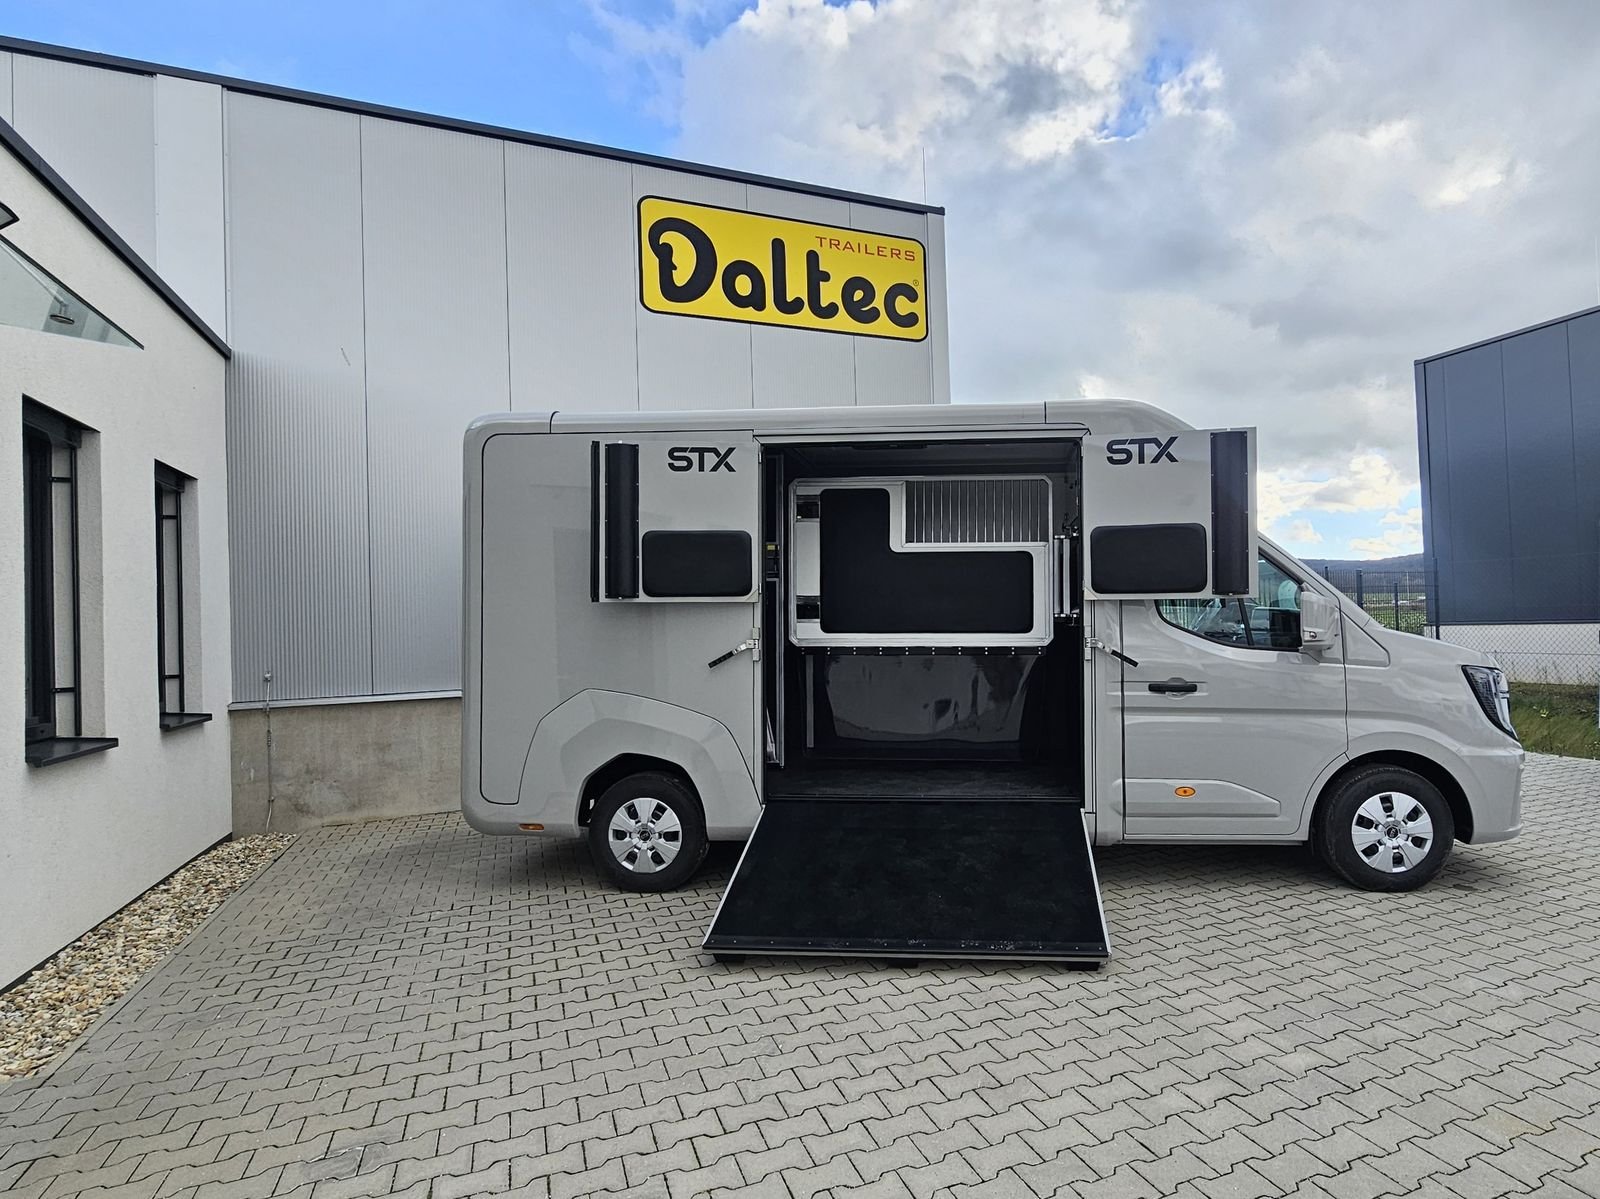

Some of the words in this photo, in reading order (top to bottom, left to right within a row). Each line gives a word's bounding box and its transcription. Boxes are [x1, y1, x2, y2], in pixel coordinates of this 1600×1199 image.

[815, 235, 915, 262] TRAILERS
[647, 217, 919, 328] Daltec
[667, 447, 736, 472] STX
[1106, 436, 1179, 465] STX
